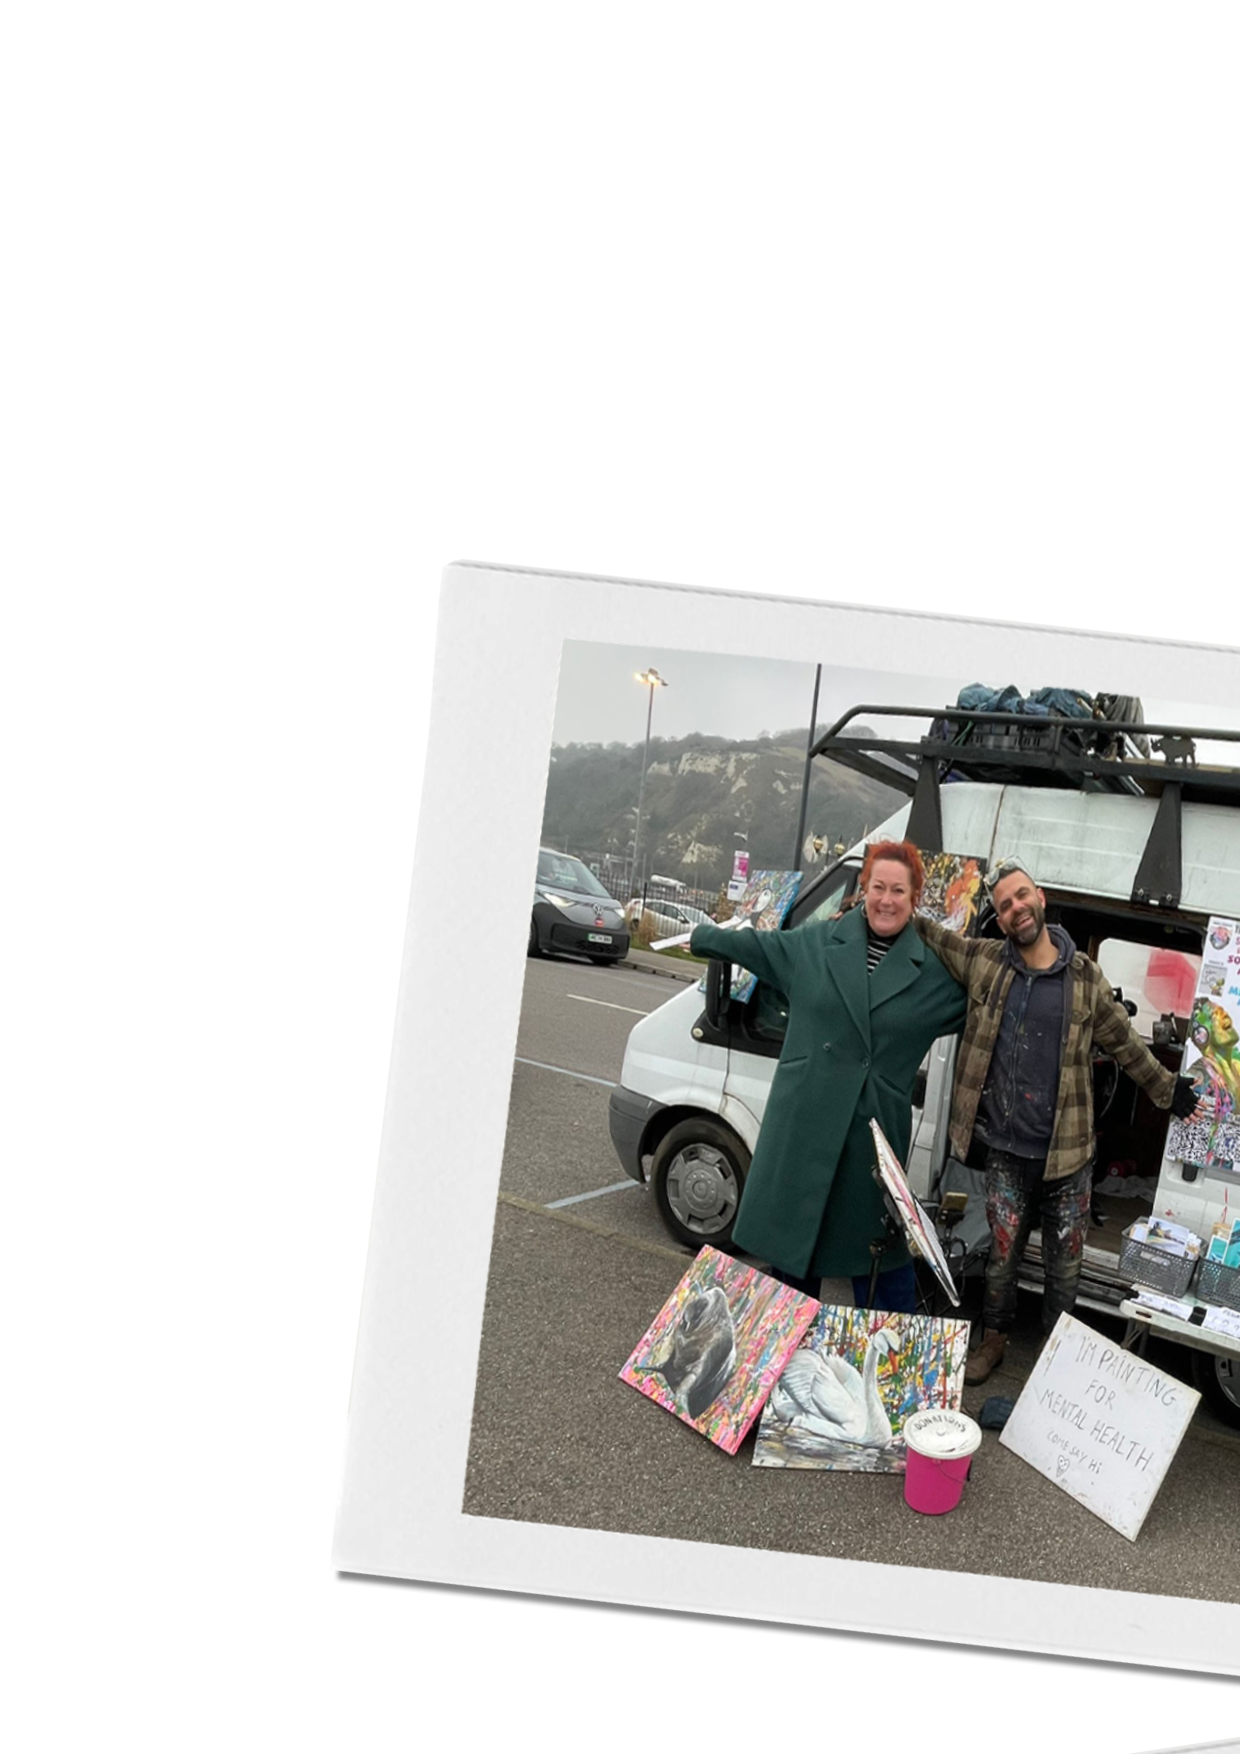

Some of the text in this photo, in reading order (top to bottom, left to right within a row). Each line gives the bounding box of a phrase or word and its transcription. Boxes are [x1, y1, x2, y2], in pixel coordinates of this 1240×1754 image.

[1085, 1379, 1116, 1411] FOR
[913, 1414, 966, 1432] DONATIONS
[1040, 1388, 1155, 1472] MENTAL HEALTH
[1047, 1431, 1069, 1451] COME
[1068, 1445, 1088, 1463] SAY
